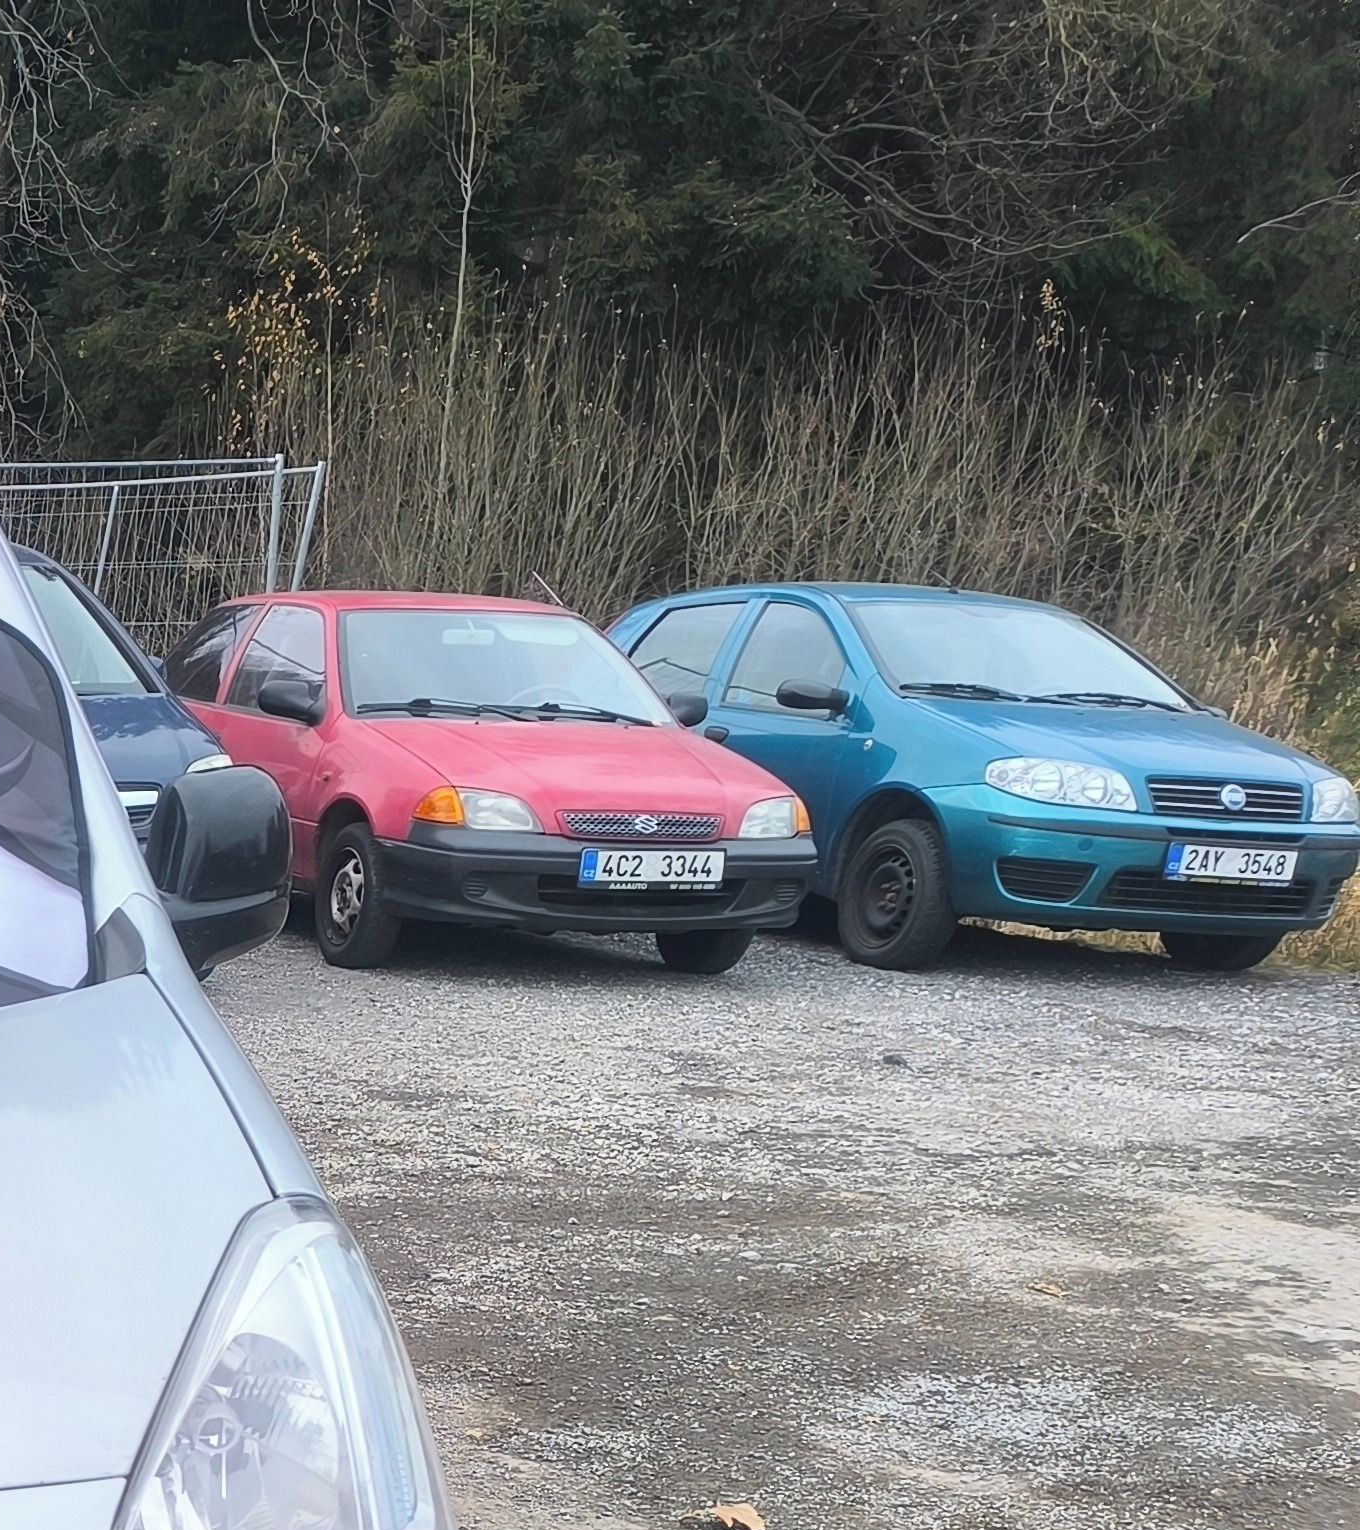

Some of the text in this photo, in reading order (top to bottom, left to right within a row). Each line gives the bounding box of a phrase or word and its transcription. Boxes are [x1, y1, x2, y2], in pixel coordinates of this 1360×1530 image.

[602, 855, 643, 877] 4C2
[661, 855, 712, 878] 3344
[1185, 849, 1225, 872] 2AY
[1238, 853, 1287, 876] 3548
